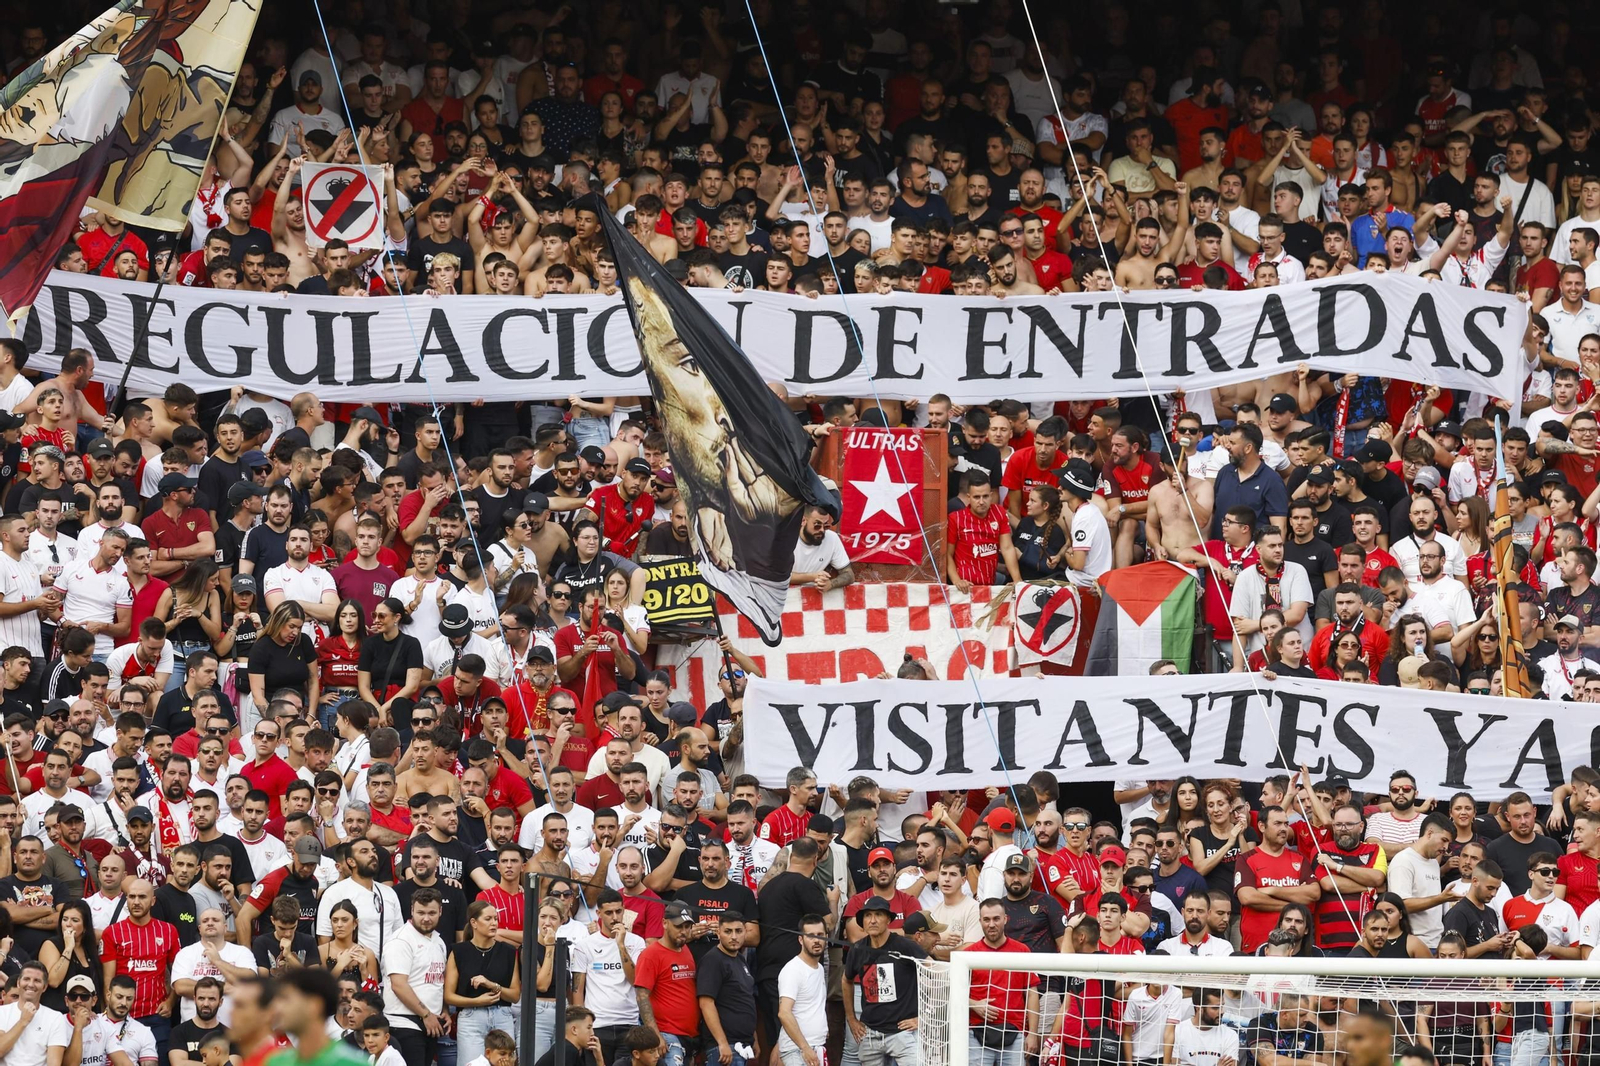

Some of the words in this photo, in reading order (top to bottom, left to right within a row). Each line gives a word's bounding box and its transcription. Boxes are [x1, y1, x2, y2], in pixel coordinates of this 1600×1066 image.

[784, 306, 924, 384] DE
[958, 283, 1506, 381] ENTRADAS
[849, 432, 920, 451] ULTRAS
[850, 532, 912, 550] 1975
[978, 543, 998, 553] NAGA
[768, 689, 1380, 780] VISITANTES
[1423, 707, 1600, 792] YA
[1261, 876, 1300, 888] Playtika
[698, 899, 729, 909] PISALO
[134, 959, 157, 969] NAGA
